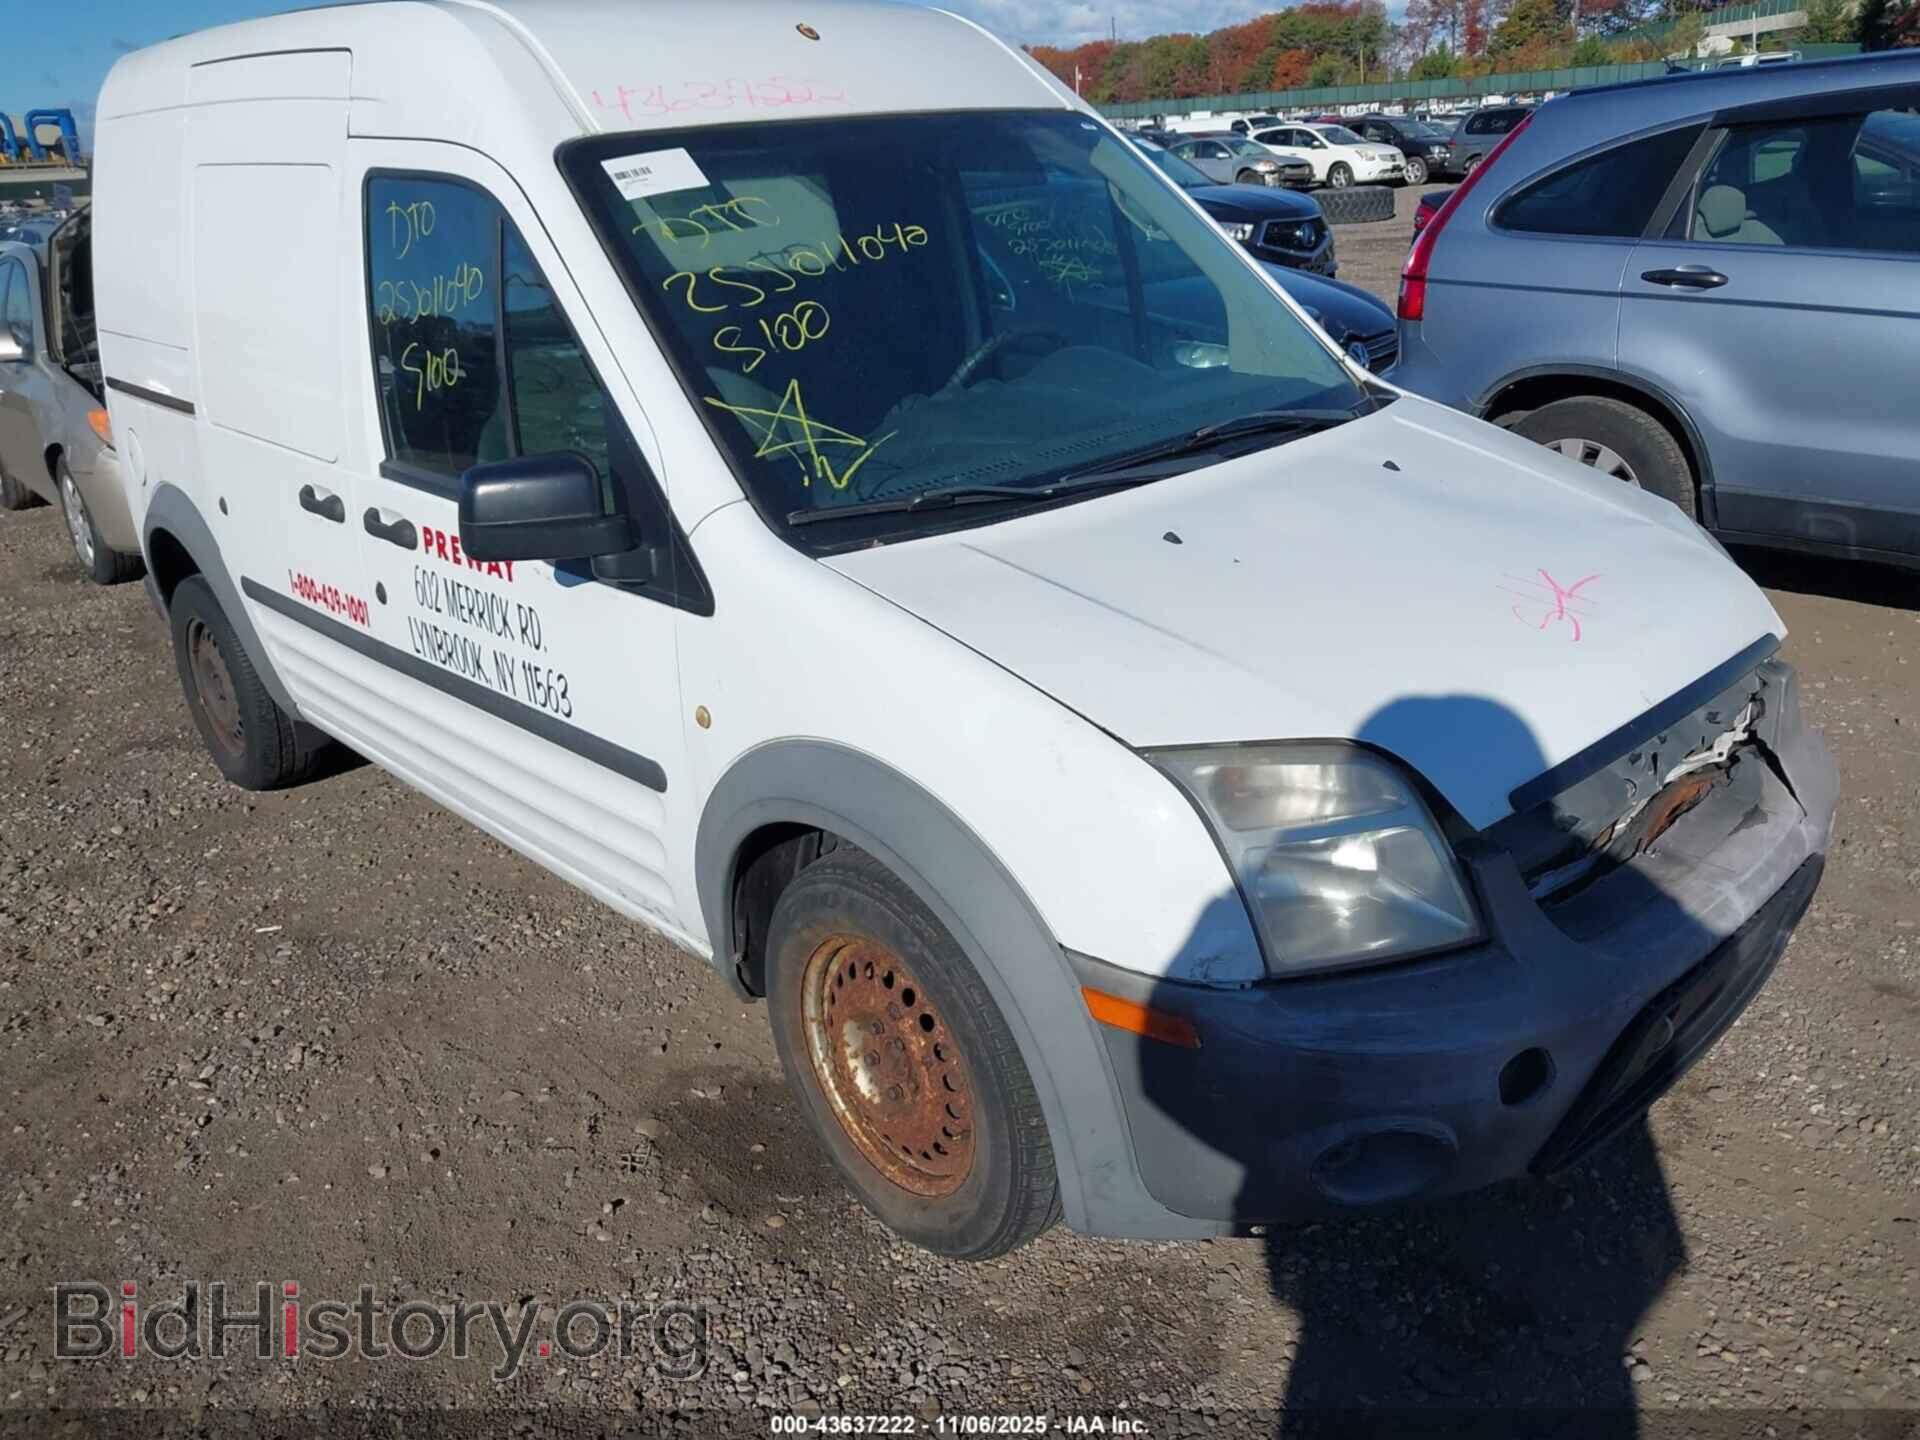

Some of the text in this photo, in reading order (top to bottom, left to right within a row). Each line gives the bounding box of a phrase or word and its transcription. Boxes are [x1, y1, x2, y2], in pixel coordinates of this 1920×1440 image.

[288, 568, 370, 628] 1-800-439-1001
[414, 564, 548, 653] 602 MERRICK RD.
[493, 649, 517, 697] NY
[522, 659, 573, 718] 11563
